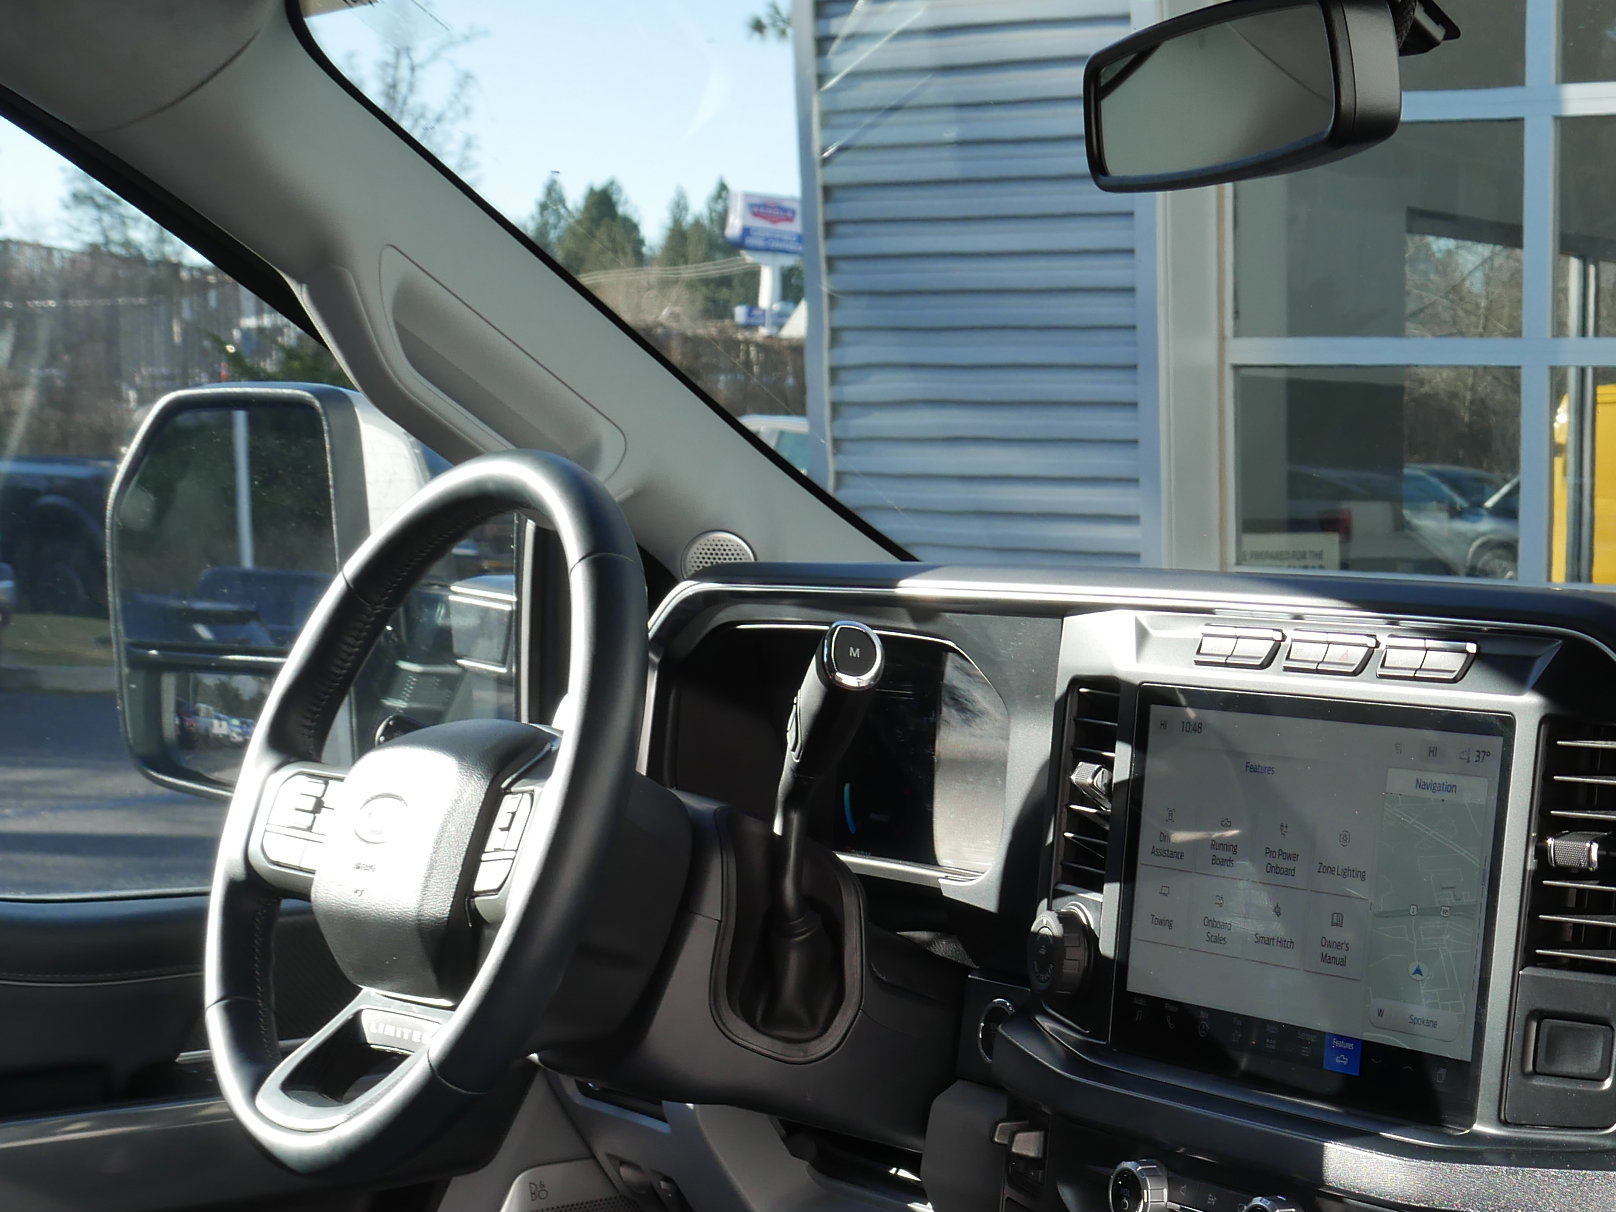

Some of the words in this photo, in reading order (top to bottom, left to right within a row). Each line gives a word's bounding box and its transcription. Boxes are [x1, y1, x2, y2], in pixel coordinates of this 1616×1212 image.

[850, 647, 860, 658] M
[1181, 720, 1202, 734] 10:48
[1245, 761, 1276, 776] Features
[1415, 777, 1457, 794] Navigation
[1151, 844, 1184, 860] Assistance
[1211, 839, 1238, 855] Running
[1265, 846, 1277, 859] Pro
[1278, 848, 1300, 862] Power
[1211, 854, 1234, 868] Boards
[1265, 862, 1296, 877] Onboard
[1317, 861, 1336, 876] Zone
[1336, 864, 1366, 881] Lighting
[1151, 913, 1173, 930] Towing
[1203, 916, 1232, 932] Onboard
[1206, 931, 1228, 945] Scales
[1254, 932, 1276, 947] Smart
[1276, 935, 1295, 950] Hitch
[1320, 936, 1350, 952] Owner's
[1320, 952, 1347, 967] Manual
[1377, 1007, 1385, 1018] W
[1409, 1013, 1438, 1029] Spokane
[1331, 1037, 1354, 1051] Features
